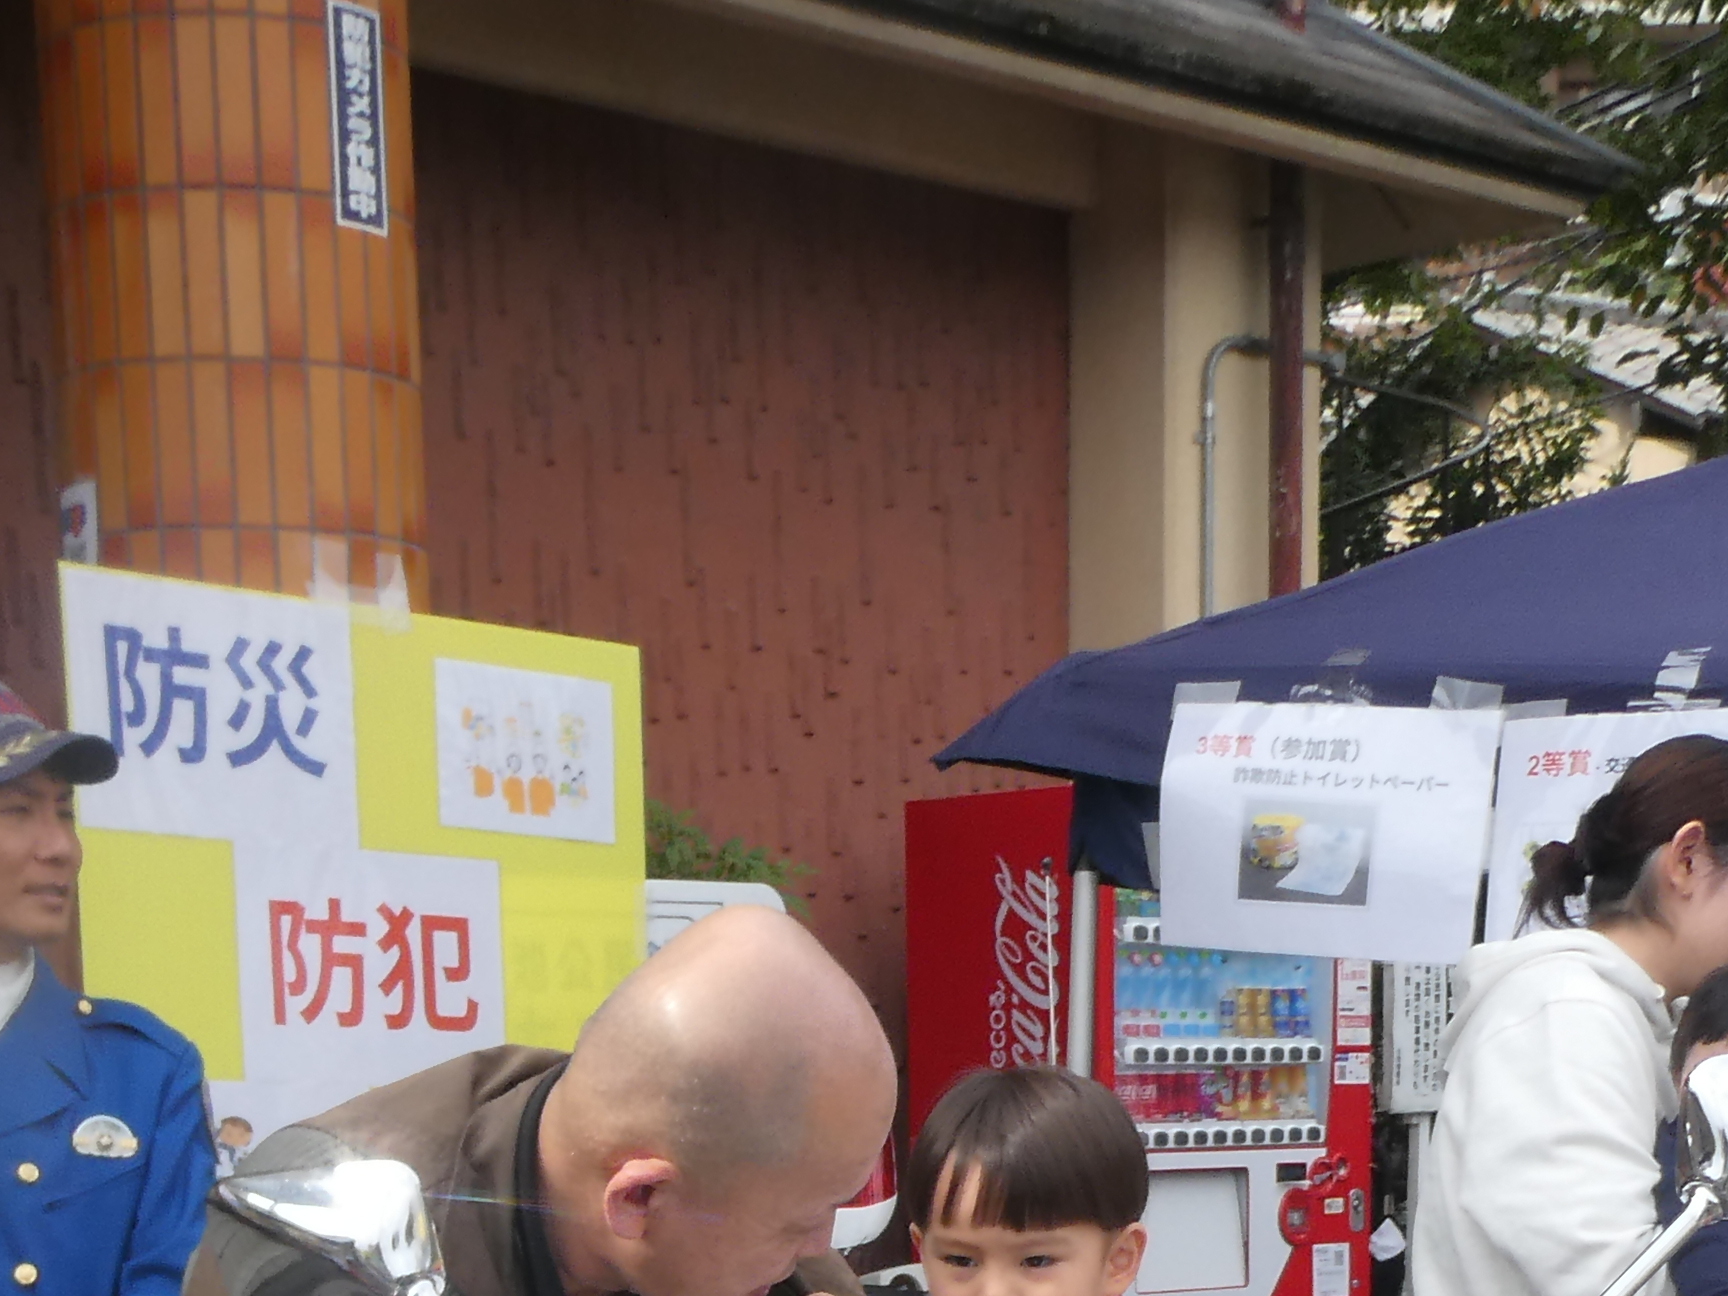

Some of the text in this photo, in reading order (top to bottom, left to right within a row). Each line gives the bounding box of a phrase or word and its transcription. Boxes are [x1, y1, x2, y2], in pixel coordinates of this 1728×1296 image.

[102, 622, 328, 779] 防災
[268, 897, 479, 1033] 防犯
[994, 855, 1060, 1067] ca-Cola
